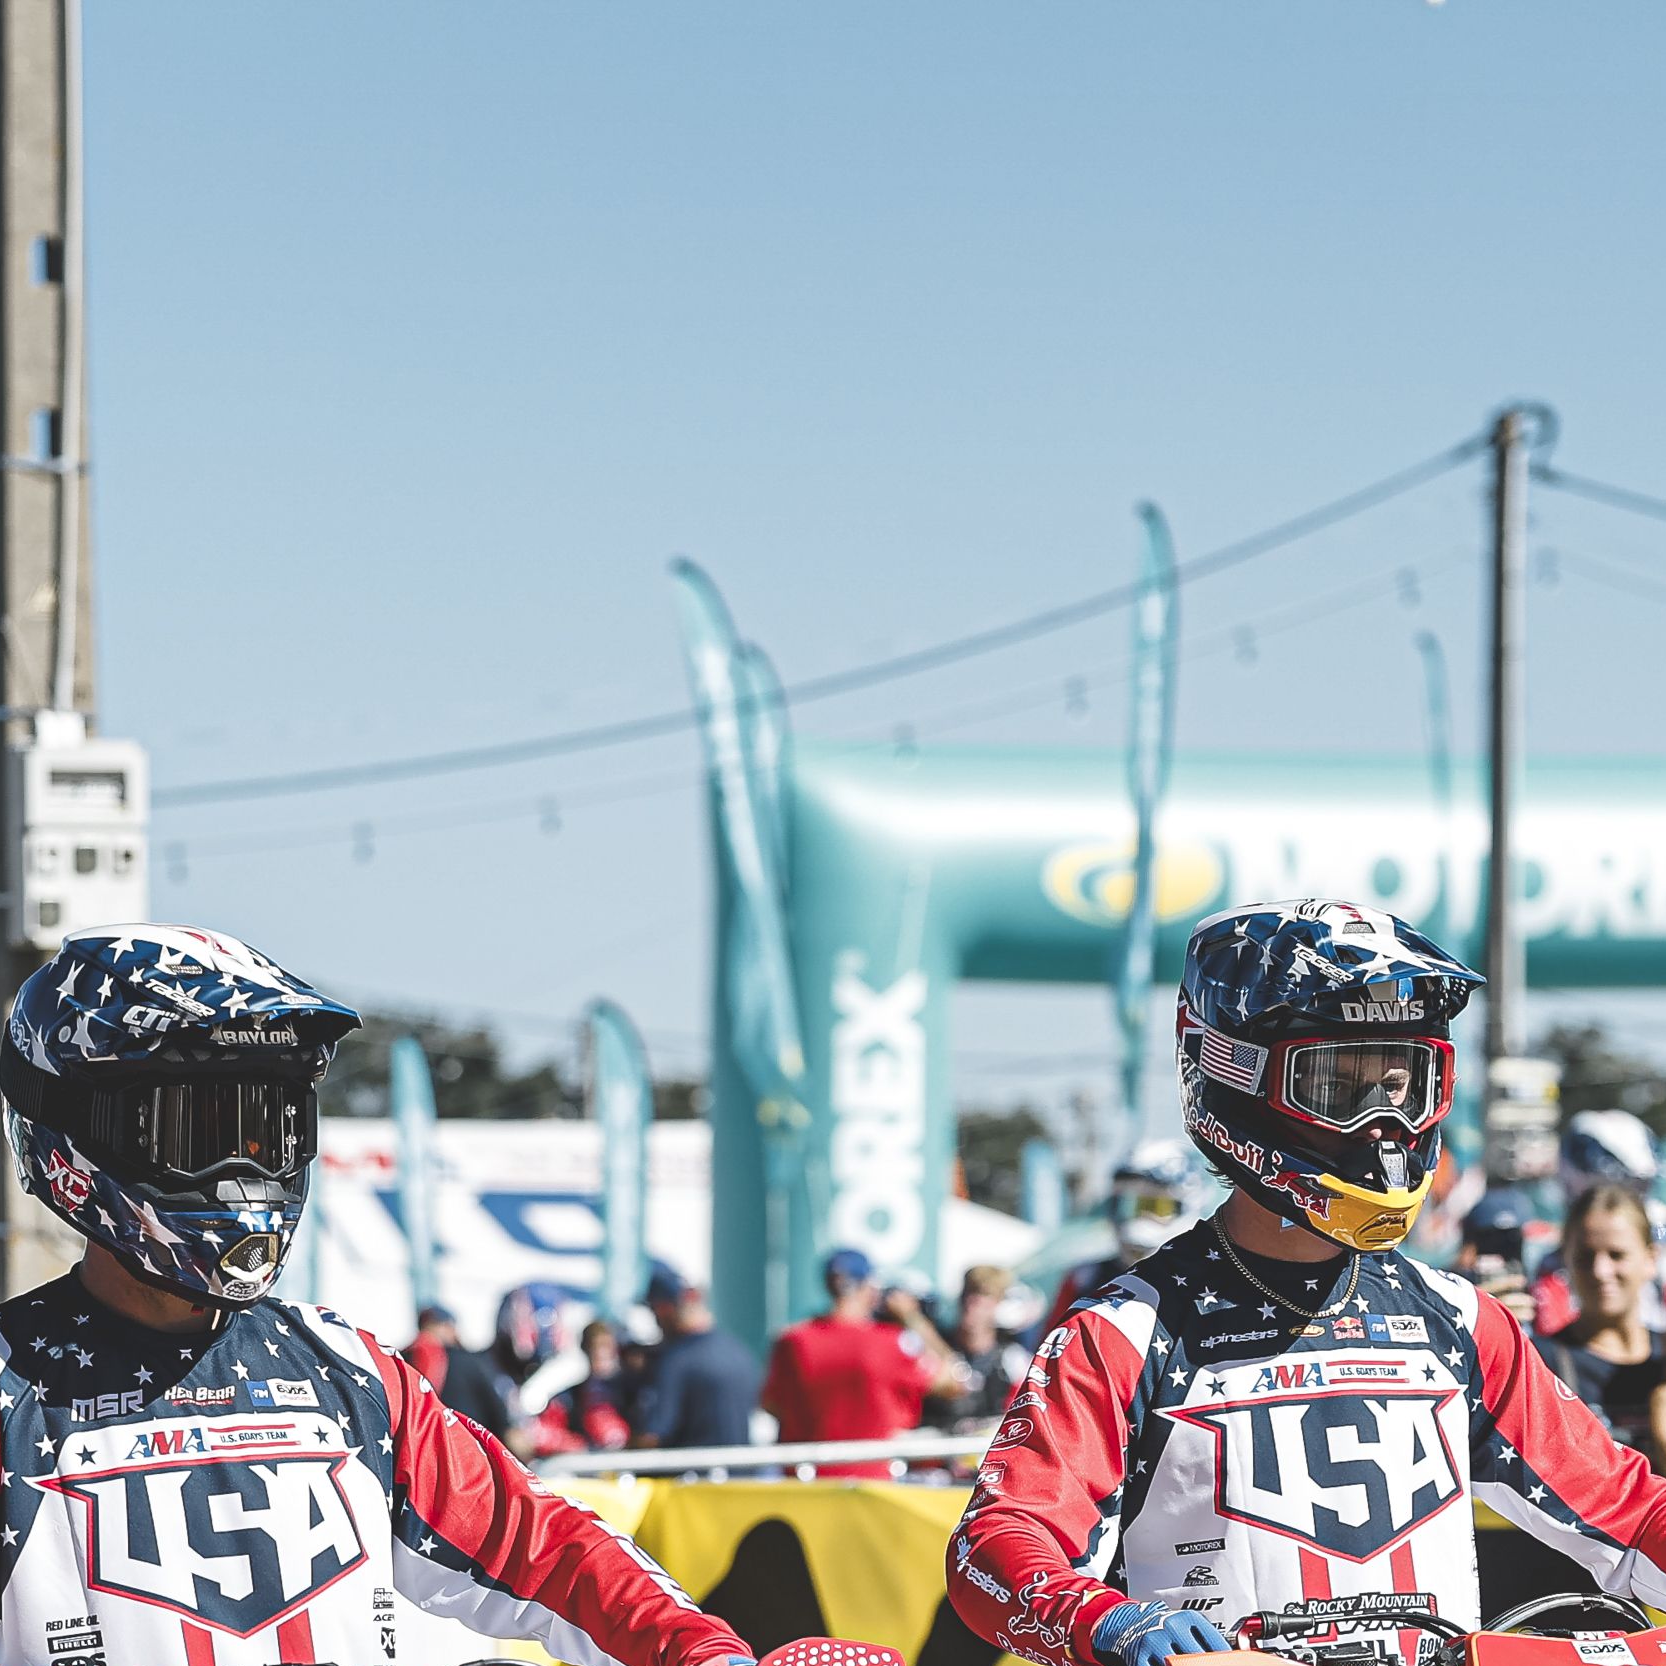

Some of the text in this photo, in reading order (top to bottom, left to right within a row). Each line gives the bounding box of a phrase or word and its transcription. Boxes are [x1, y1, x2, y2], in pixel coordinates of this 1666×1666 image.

[1341, 1001, 1425, 1022] DAVIS
[222, 1029, 294, 1046] BAYLOR
[1200, 1328, 1279, 1349] alpinestars
[1251, 1363, 1327, 1393] AMA
[1380, 1367, 1398, 1376] TEAM
[71, 1391, 143, 1421] MSR
[196, 1386, 236, 1400] BEAR
[126, 1428, 210, 1459] AMA
[239, 1432, 264, 1441] 6DAYS
[266, 1431, 288, 1440] TEAM
[1216, 1399, 1459, 1538] USA
[65, 1461, 364, 1610] USA
[1190, 1541, 1222, 1554] MOTOREX
[1306, 1594, 1429, 1615] ROCKY MOUNTAIN
[45, 1618, 65, 1632] RED
[66, 1616, 85, 1630] LINE
